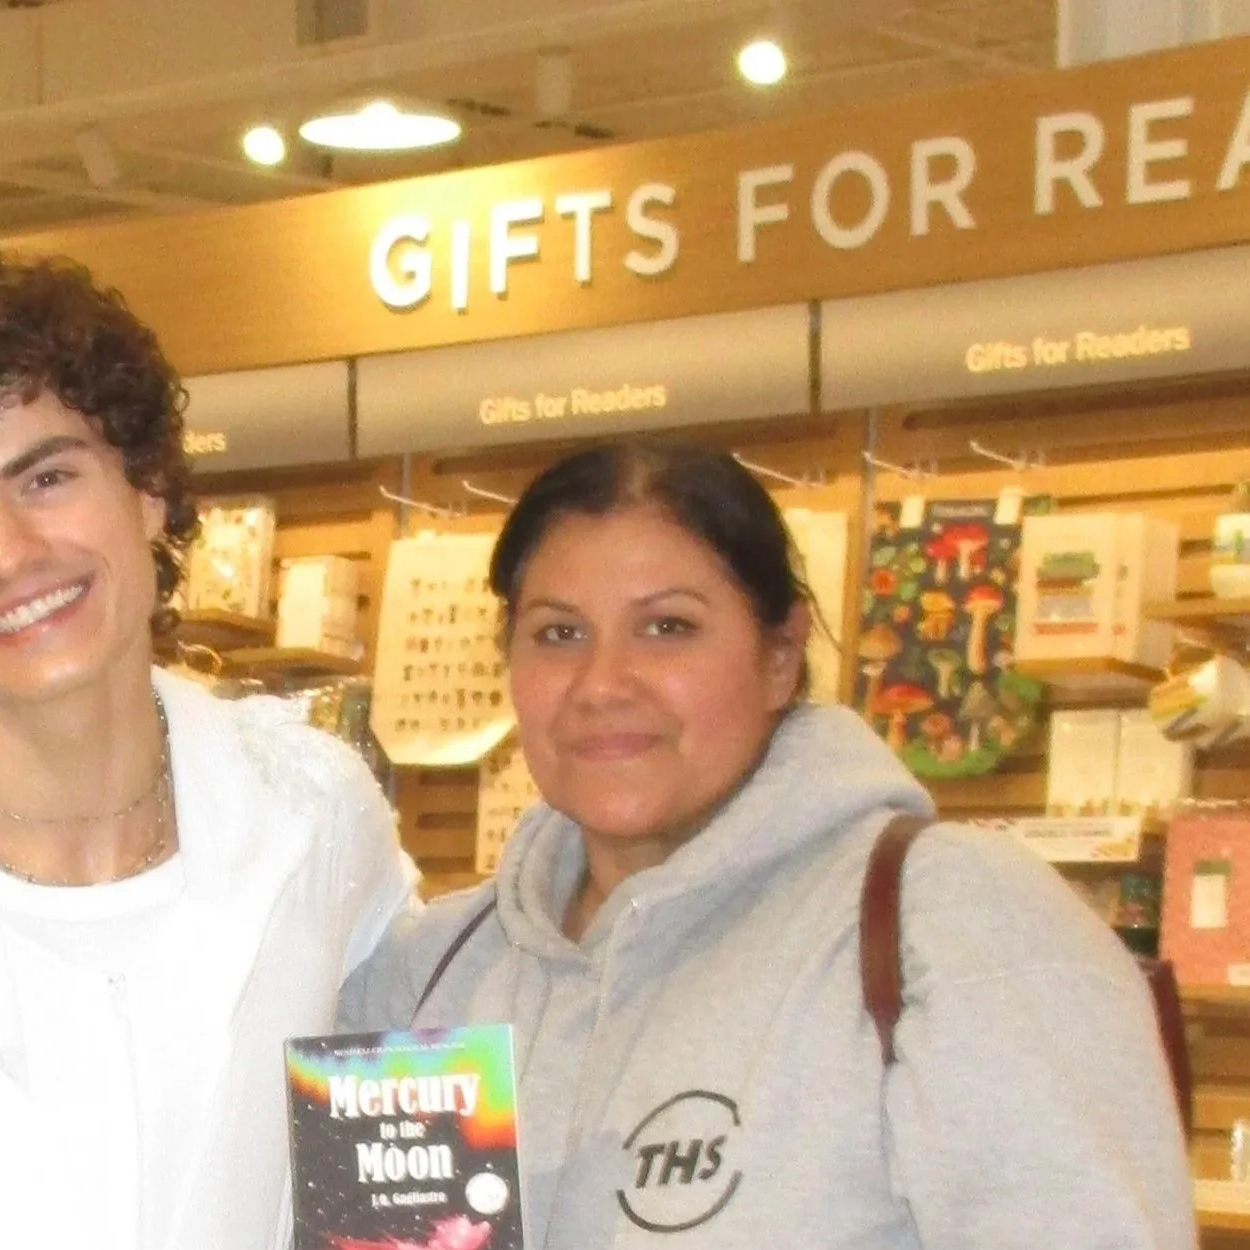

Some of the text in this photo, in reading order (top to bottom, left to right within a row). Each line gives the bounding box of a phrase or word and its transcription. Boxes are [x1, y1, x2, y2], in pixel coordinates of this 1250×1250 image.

[368, 182, 681, 314] GIFTS
[736, 135, 978, 265] FOR
[965, 324, 1192, 373] Gifts for Readers
[479, 383, 667, 425] Gifts for Readers
[327, 1072, 481, 1119] Mercury
[379, 1119, 427, 1140] to the
[354, 1141, 455, 1185] Moon
[635, 1134, 728, 1189] THS
